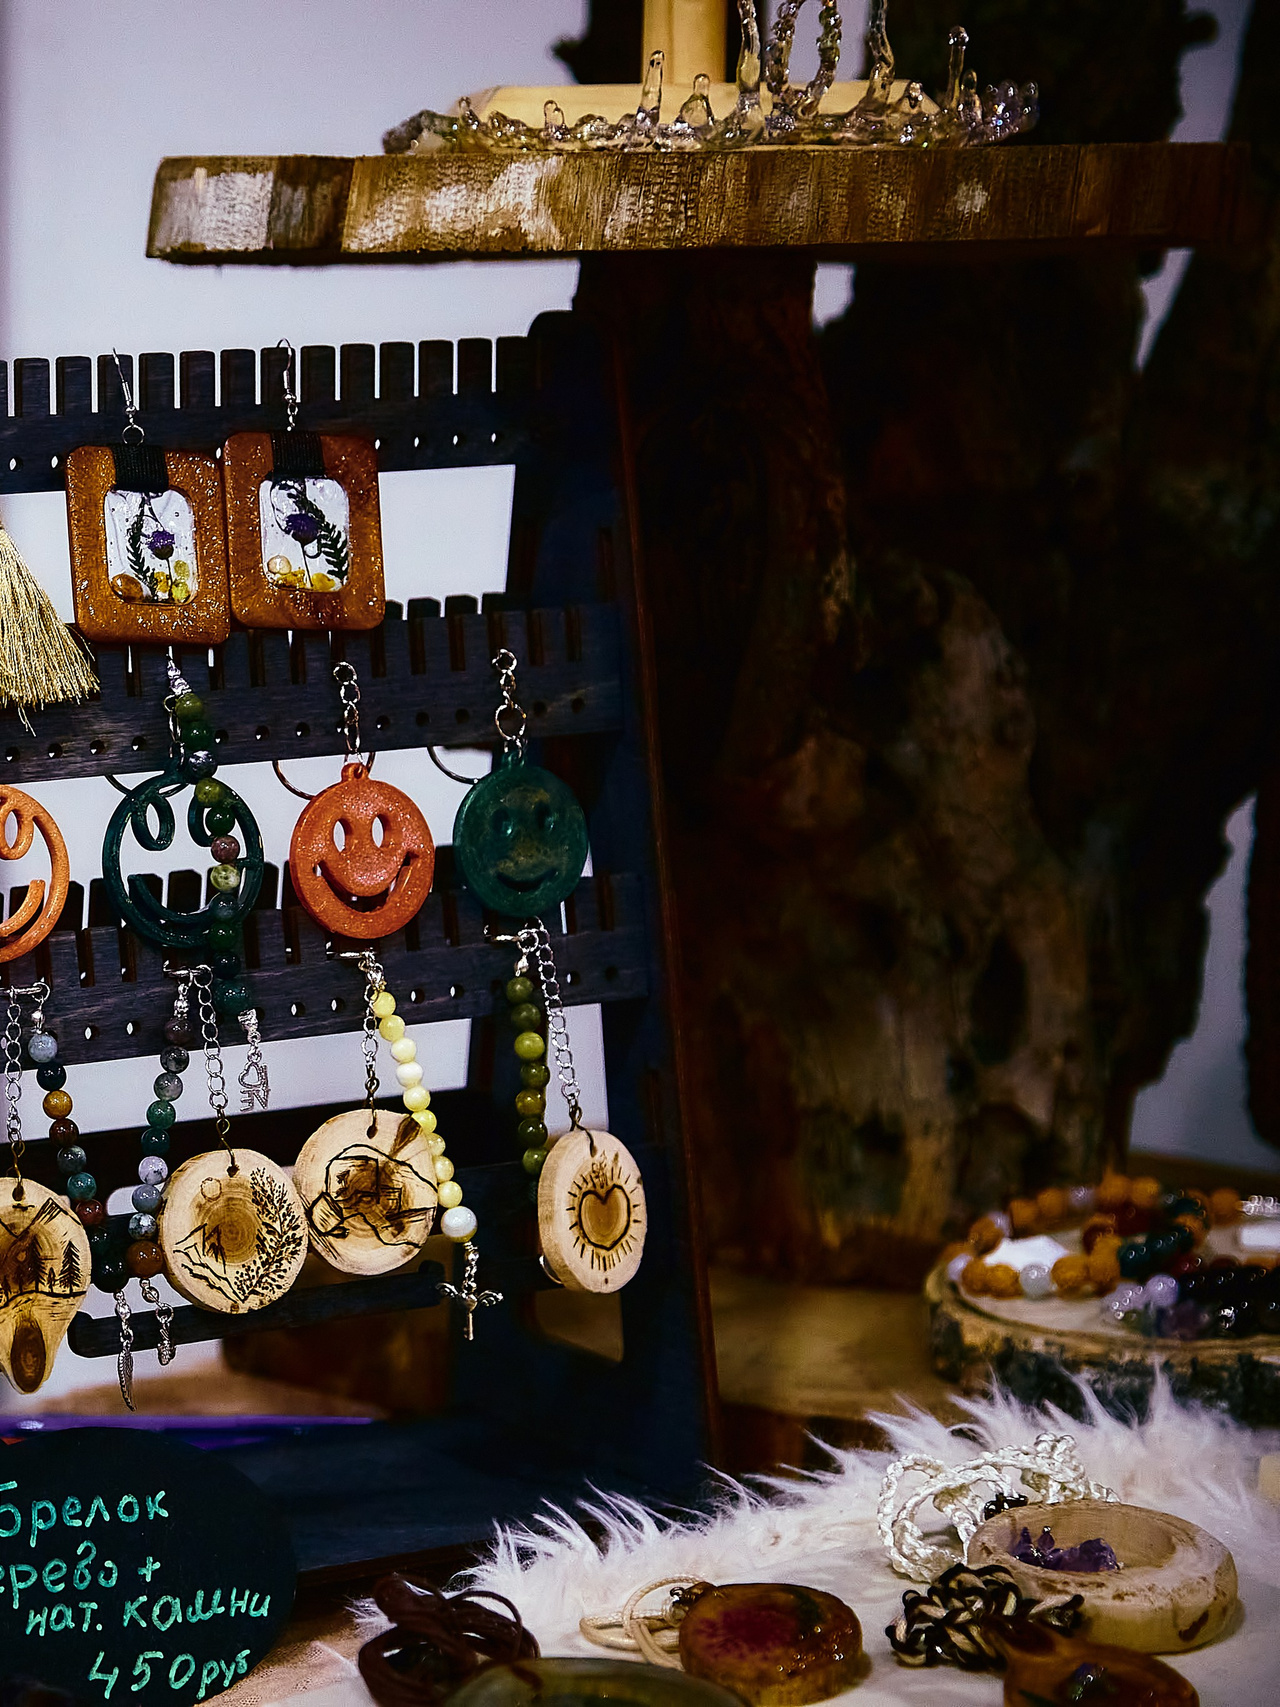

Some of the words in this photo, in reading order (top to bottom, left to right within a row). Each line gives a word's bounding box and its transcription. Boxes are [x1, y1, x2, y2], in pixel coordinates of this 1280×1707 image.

[137, 1556, 161, 1582] +
[25, 1601, 104, 1637] нат.
[122, 1587, 271, 1632] камни
